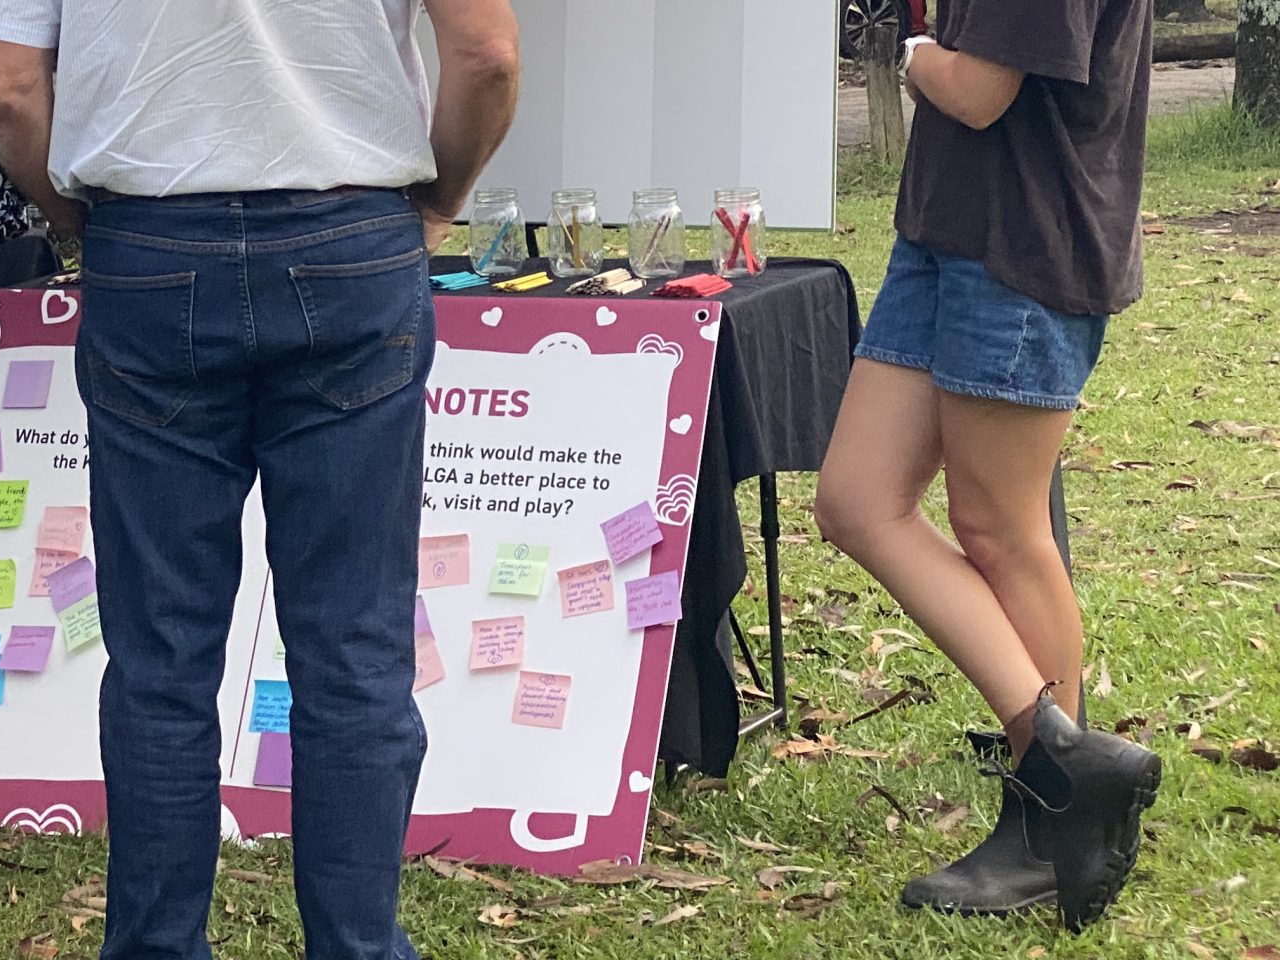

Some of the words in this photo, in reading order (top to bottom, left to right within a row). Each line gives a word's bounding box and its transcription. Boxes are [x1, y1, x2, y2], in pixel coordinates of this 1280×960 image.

[425, 387, 530, 418] NOTES
[15, 428, 56, 444] What
[60, 429, 79, 445] do
[53, 453, 78, 469] the
[430, 442, 475, 459] think
[480, 445, 534, 462] would
[539, 447, 588, 464] make
[593, 448, 622, 465] the
[423, 467, 458, 484] LGA
[463, 473, 474, 485] a
[479, 469, 535, 487] better
[538, 472, 587, 492] place
[592, 475, 610, 491] to
[443, 493, 482, 511] visit
[486, 496, 520, 513] and
[524, 497, 574, 519] play?
